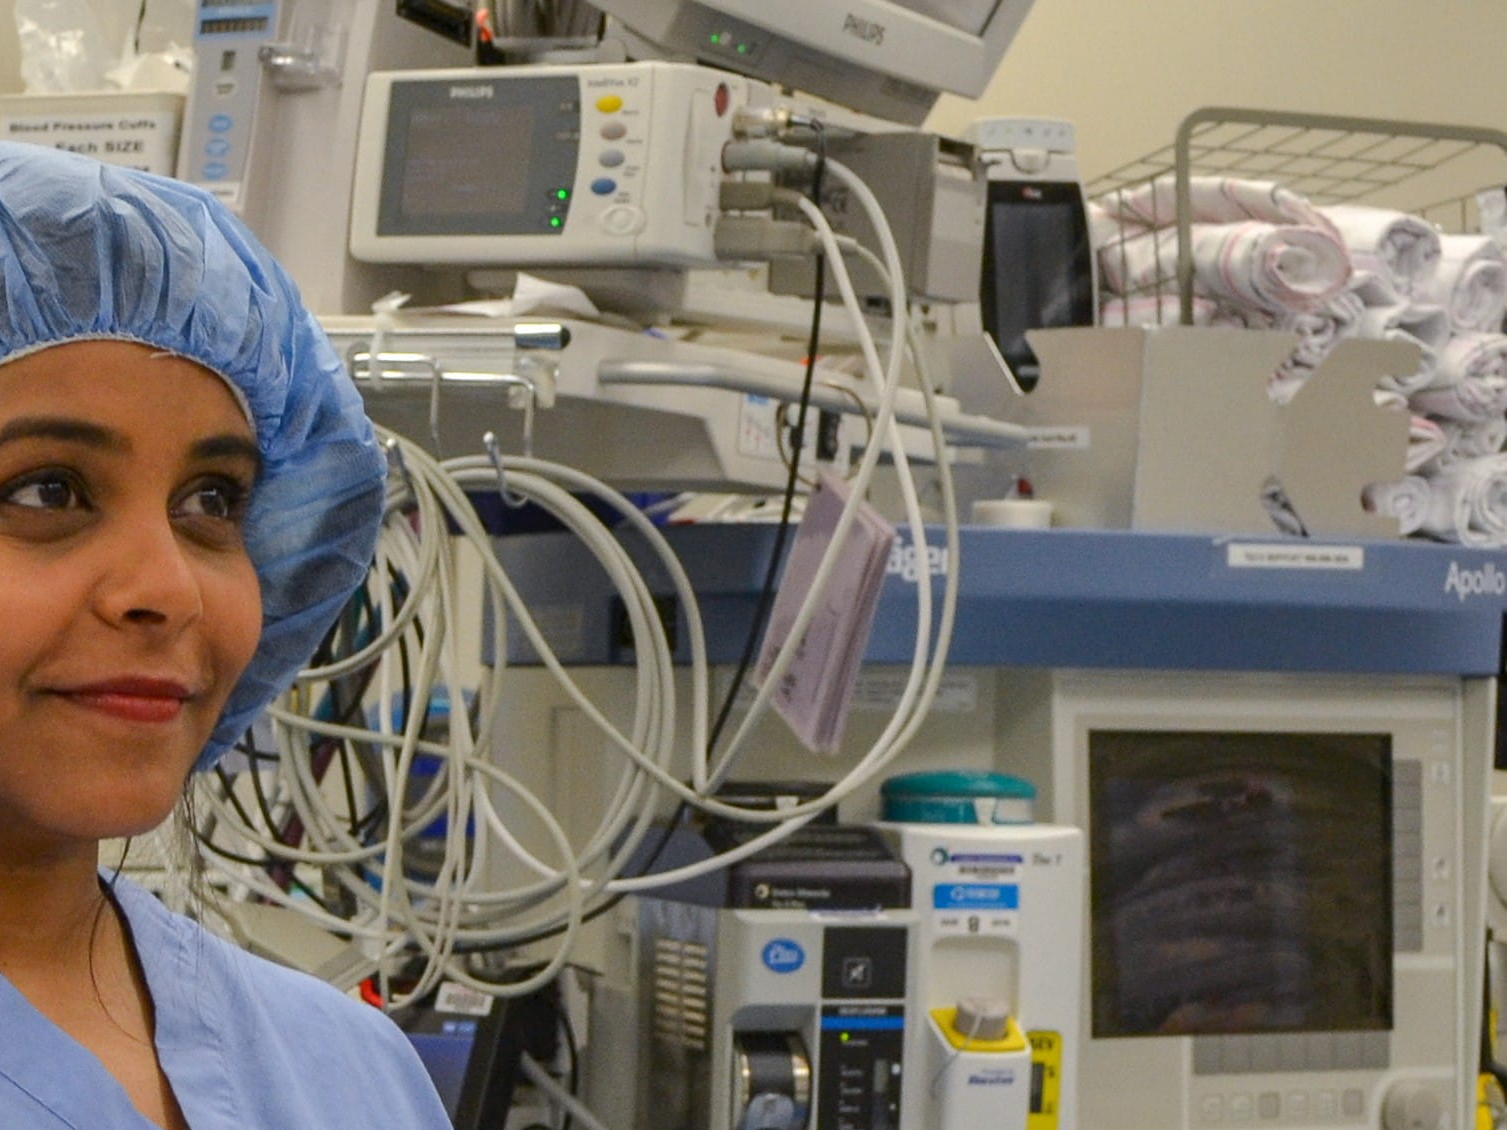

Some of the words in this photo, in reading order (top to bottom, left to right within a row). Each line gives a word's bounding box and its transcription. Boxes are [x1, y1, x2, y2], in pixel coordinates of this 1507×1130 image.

[9, 121, 49, 132] Blood
[53, 120, 113, 132] Pressure
[118, 117, 157, 131] Cuffs
[105, 140, 143, 154] SIZE
[1444, 561, 1505, 603] Apollo
